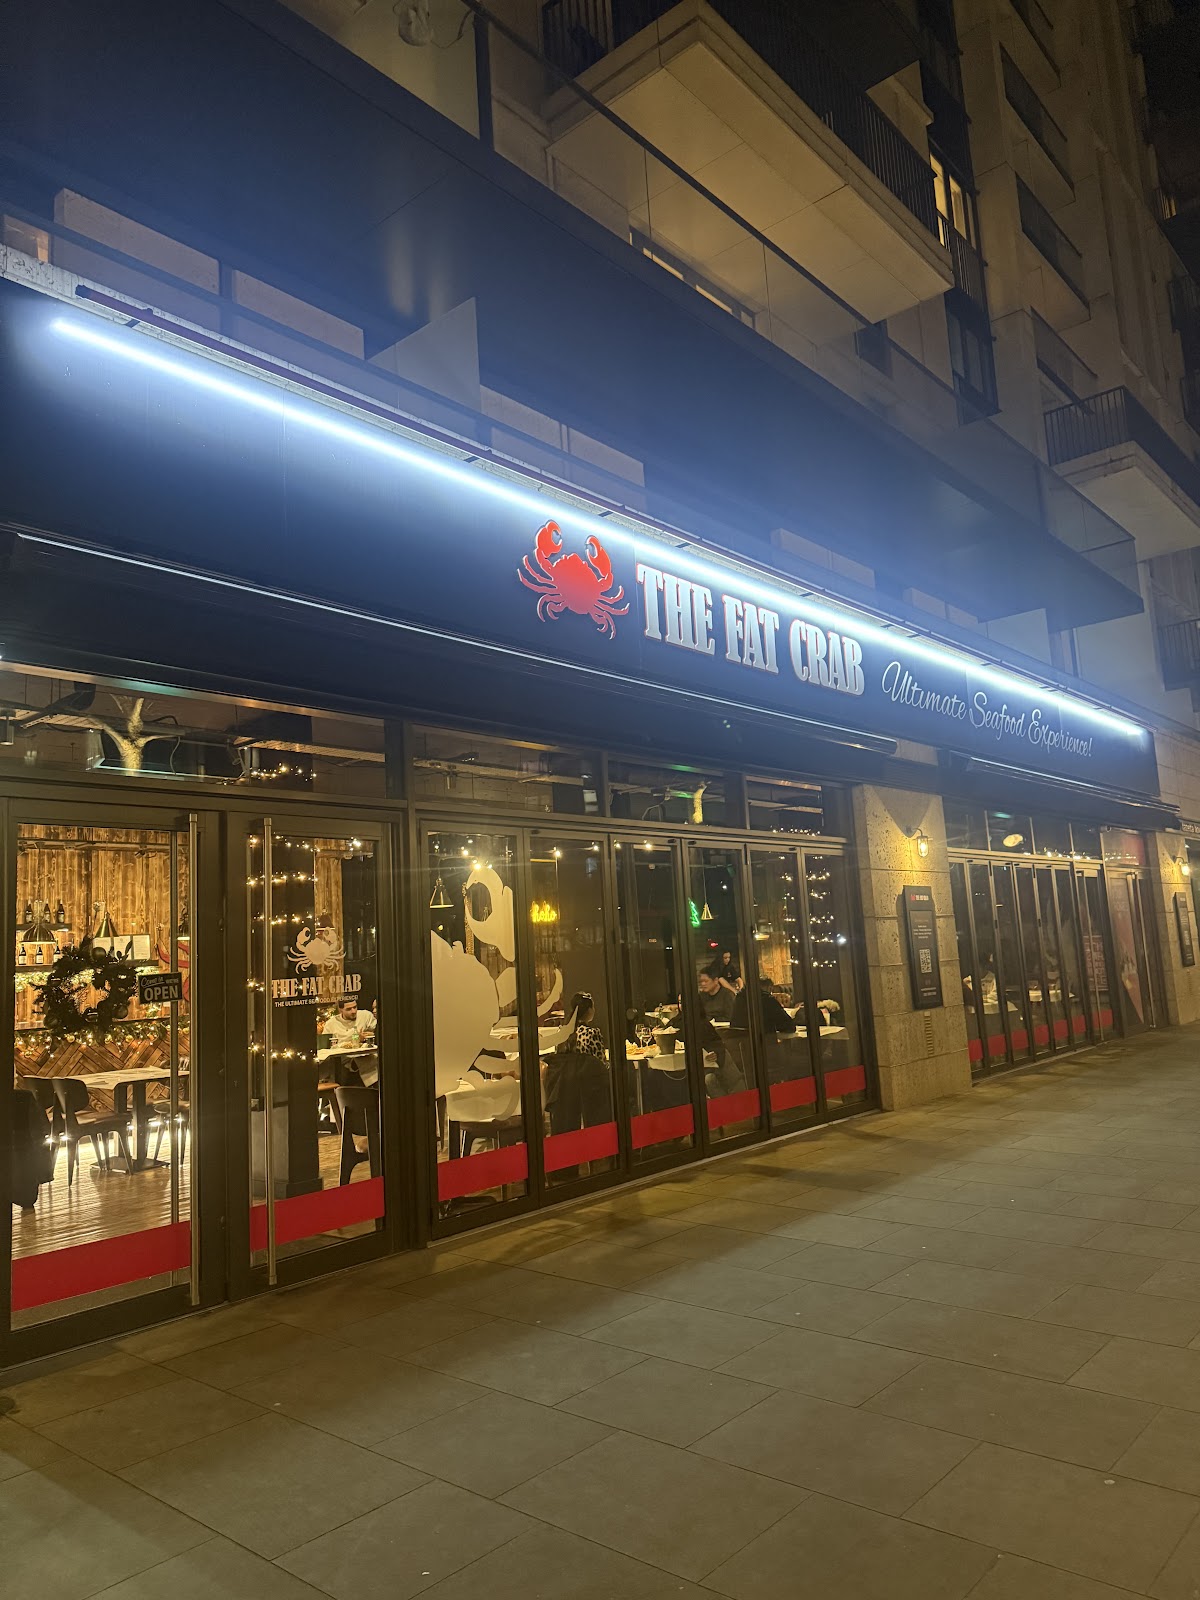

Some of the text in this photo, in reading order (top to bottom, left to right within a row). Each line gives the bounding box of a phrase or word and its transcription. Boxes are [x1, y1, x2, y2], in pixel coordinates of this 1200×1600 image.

[635, 562, 865, 697] THE FAT CRAB
[881, 660, 1093, 757] Ultimate Seafood Experience!
[530, 901, 557, 923] hoho
[144, 985, 178, 1001] OPEN
[271, 973, 362, 998] THE FAT CRAB
[285, 999, 308, 1007] ULTIMATE
